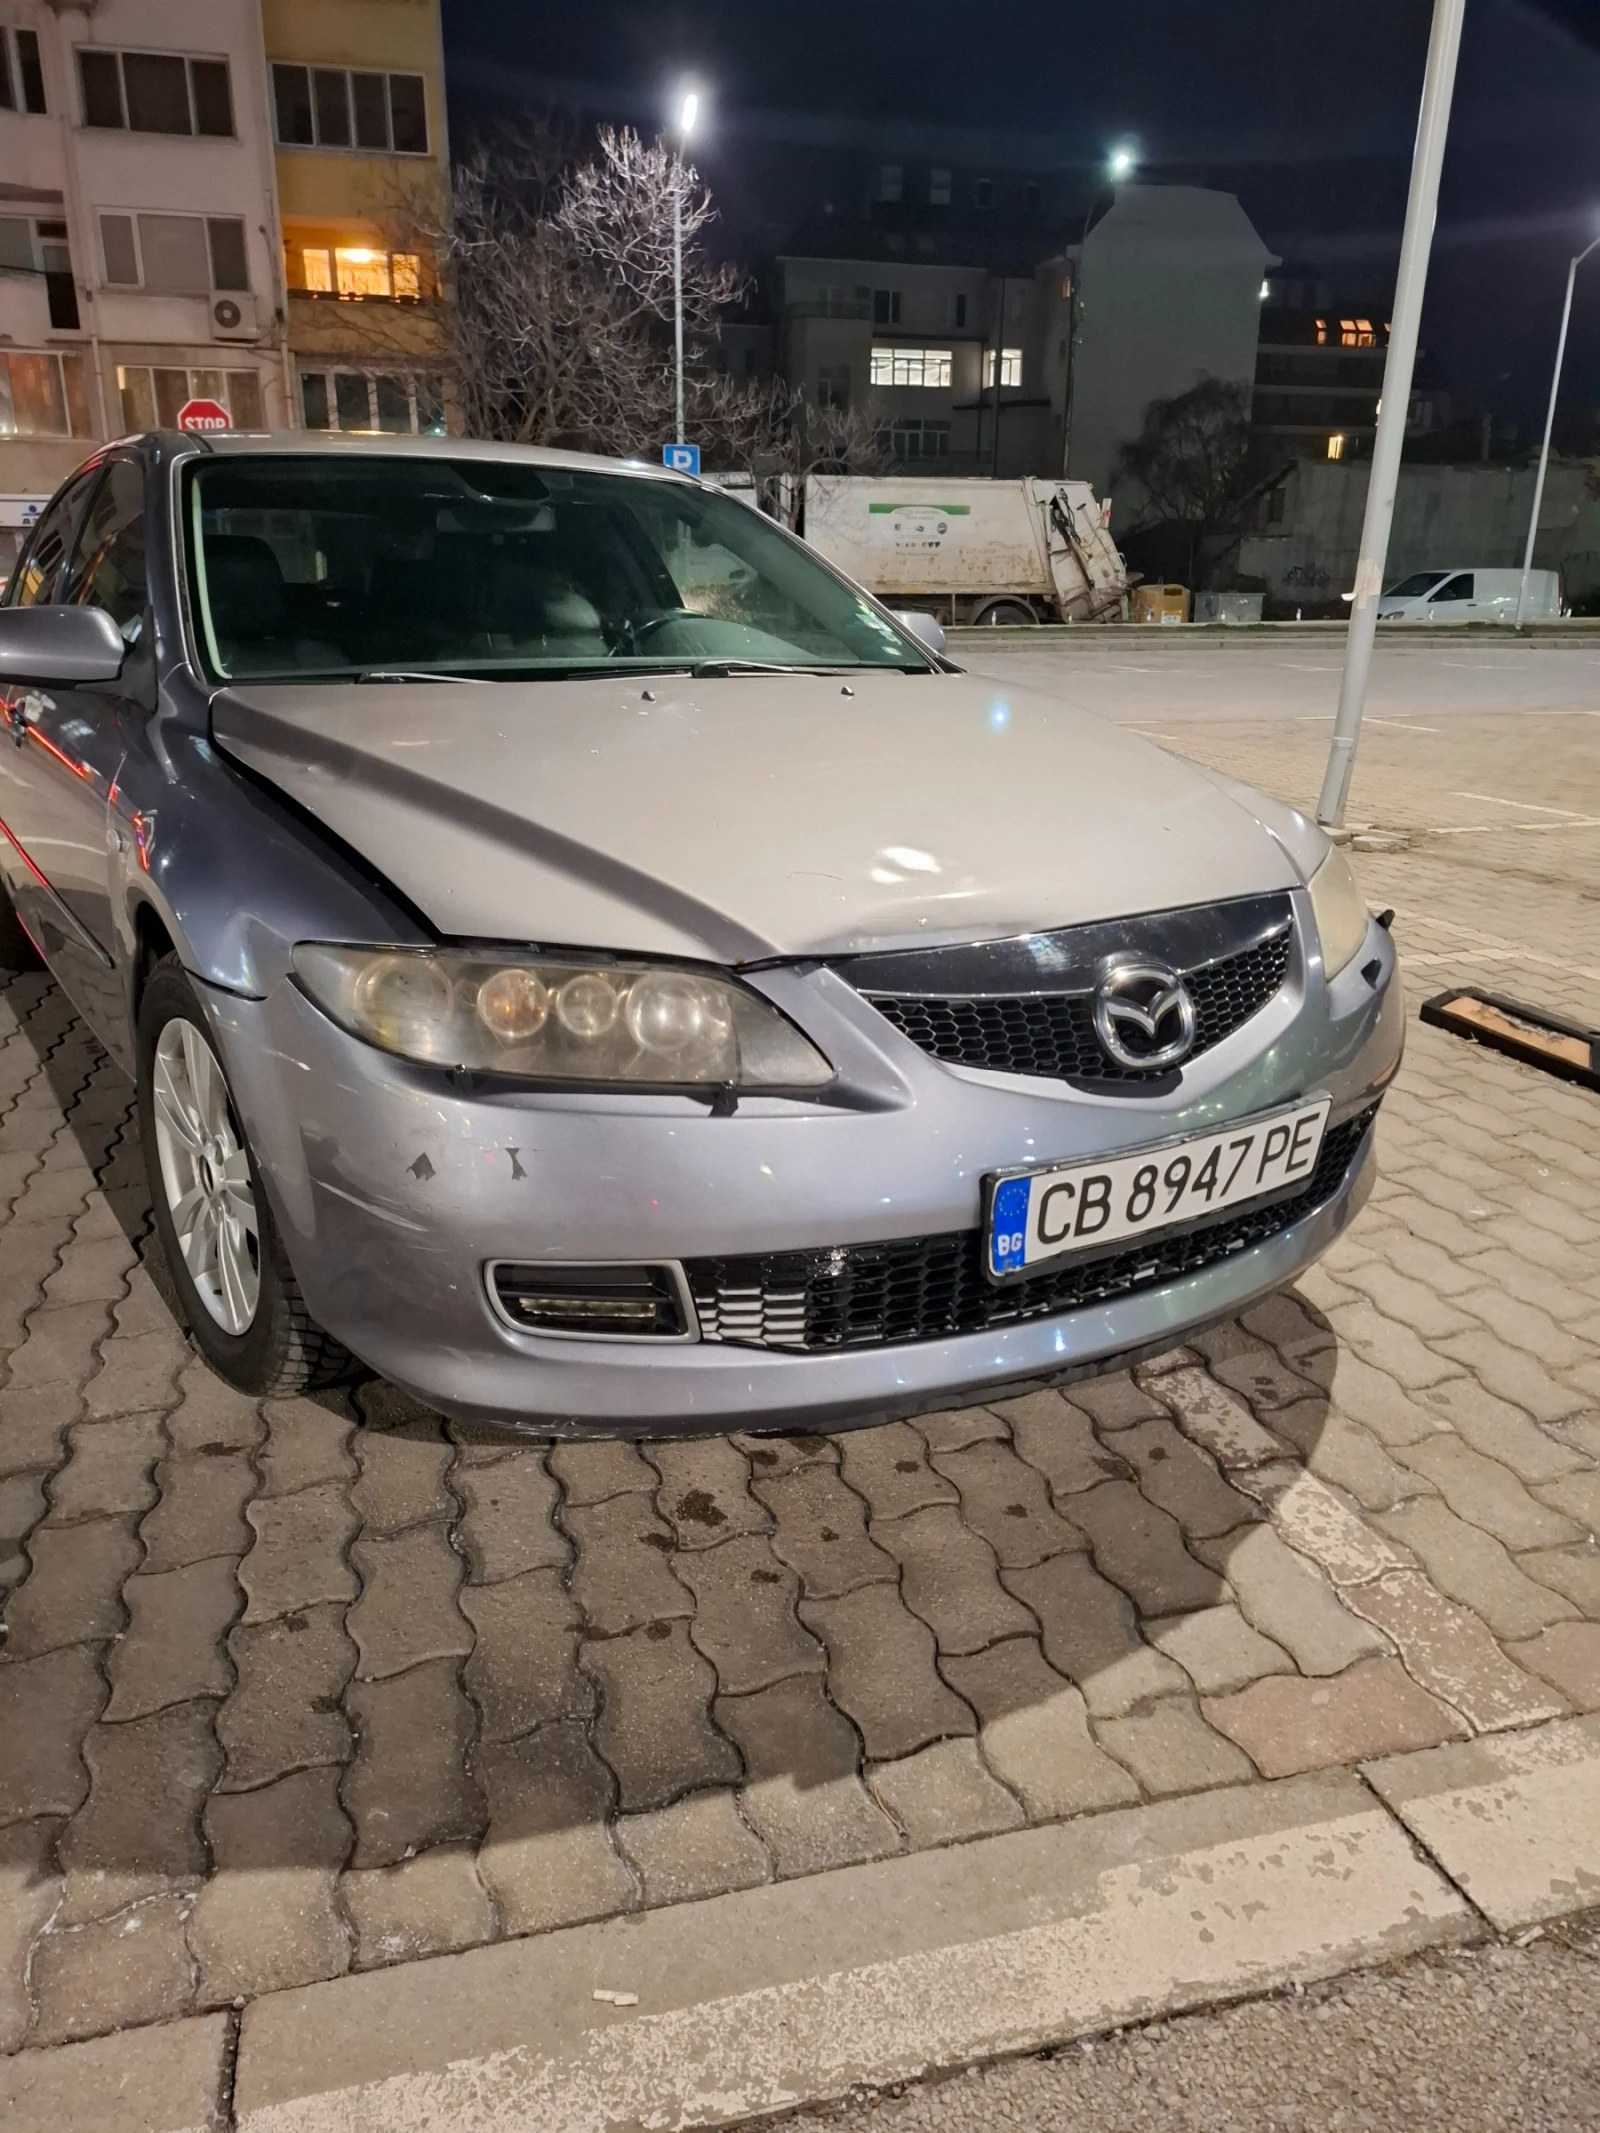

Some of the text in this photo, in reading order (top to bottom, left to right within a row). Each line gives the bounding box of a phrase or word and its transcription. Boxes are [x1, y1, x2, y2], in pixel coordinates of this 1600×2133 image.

[185, 416, 226, 430] STOP
[673, 450, 693, 471] P
[1037, 1112, 1321, 1245] CB 8947 PE
[997, 1231, 1023, 1257] BG
